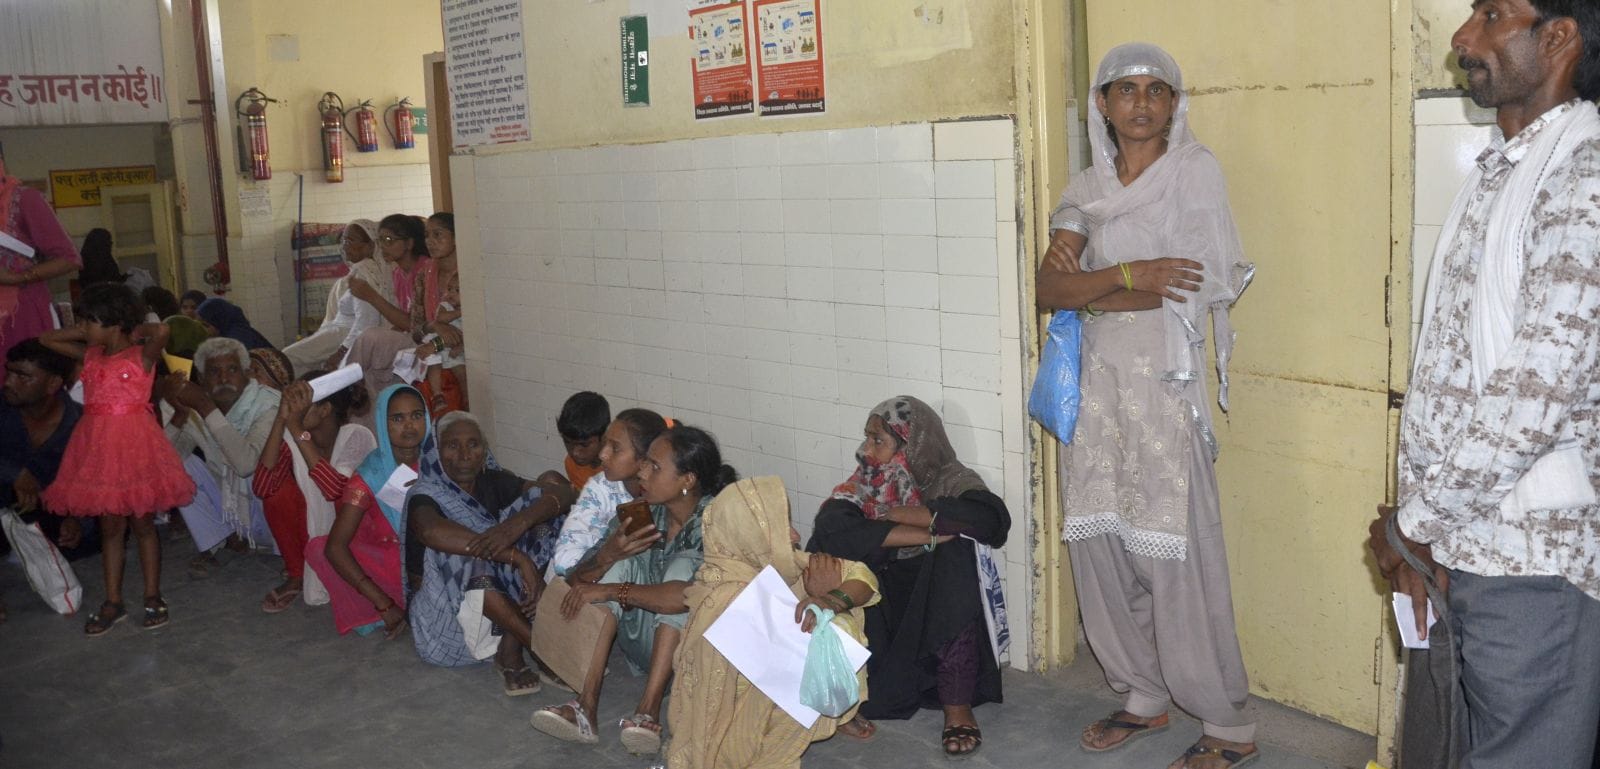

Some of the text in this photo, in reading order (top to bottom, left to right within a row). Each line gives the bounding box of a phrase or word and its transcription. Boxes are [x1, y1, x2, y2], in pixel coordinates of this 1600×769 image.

[17, 74, 78, 105] जान
[80, 74, 101, 103] न
[629, 83, 638, 91] है
